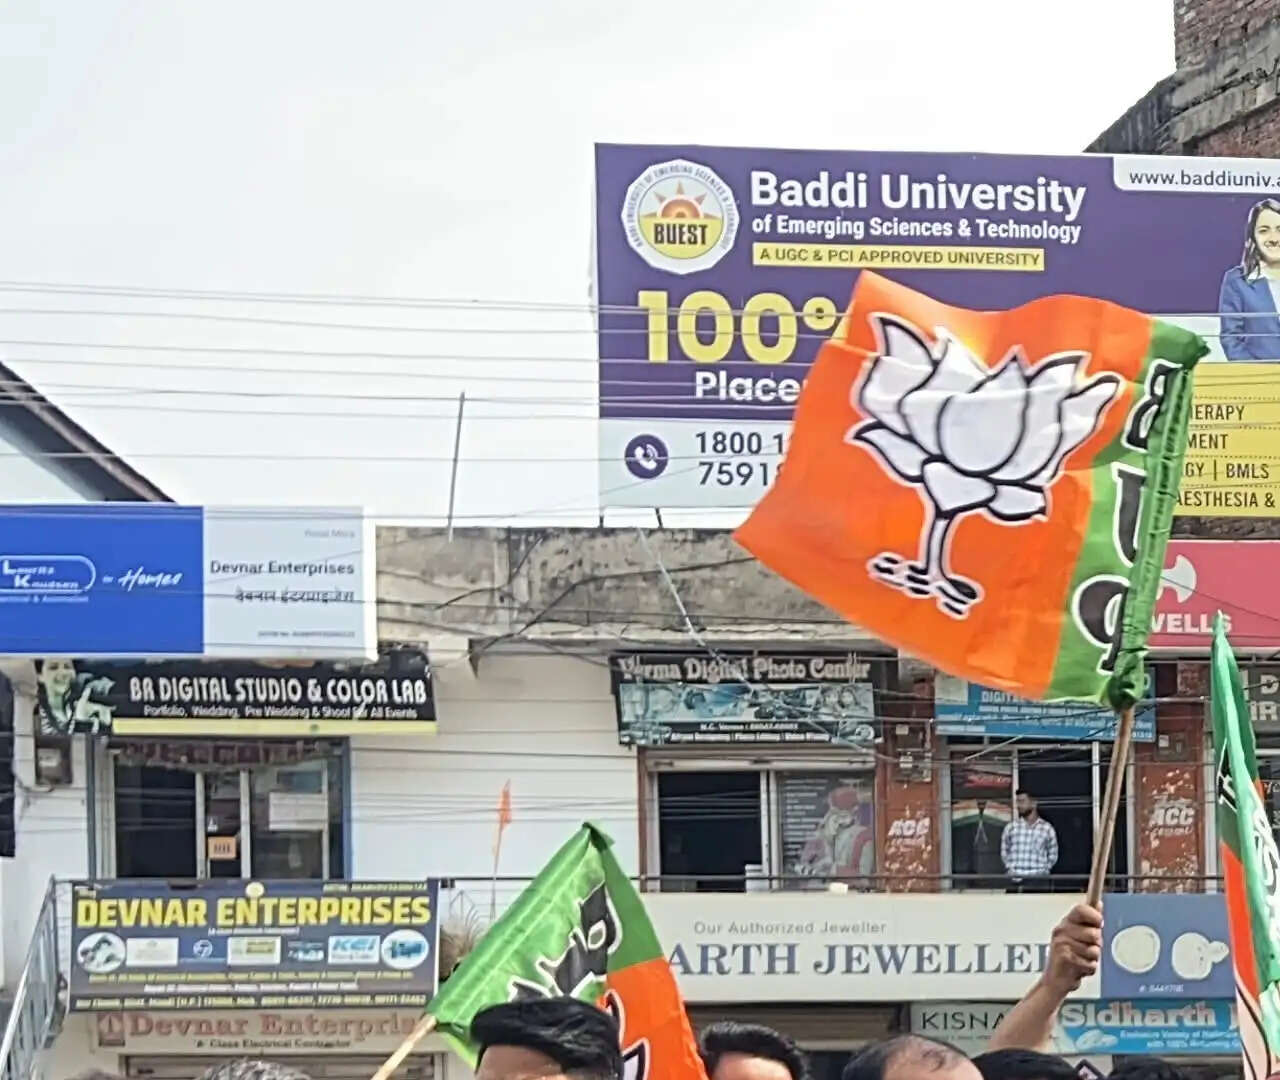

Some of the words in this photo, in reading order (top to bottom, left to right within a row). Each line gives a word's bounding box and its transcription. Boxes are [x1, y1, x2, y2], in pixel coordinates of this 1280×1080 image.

[750, 170, 868, 209] Baddi
[880, 174, 1087, 222] University
[653, 223, 708, 246] BUEST
[751, 213, 772, 234] of
[776, 214, 865, 239] Emerging
[869, 216, 953, 237] Sciences
[958, 219, 972, 237] &
[975, 218, 1082, 244] Technology
[759, 249, 771, 261] A
[774, 249, 809, 262] UGC
[812, 249, 823, 262] &
[828, 250, 854, 263] PCI
[858, 251, 944, 264] APPROVED
[947, 252, 1041, 266] UNIVERSITY
[695, 371, 804, 402] Place
[695, 431, 762, 454] 1800
[699, 462, 786, 486] 7591
[1226, 463, 1270, 479] BMLS
[1264, 492, 1276, 508] &
[210, 559, 263, 575] Devnar
[268, 559, 355, 577] Enterprises
[752, 657, 807, 680] Photo
[809, 658, 871, 680] Center
[159, 676, 231, 702] DIGITAL
[235, 677, 301, 702] STUDIO
[307, 679, 323, 702] &
[326, 679, 388, 703] COLOR
[392, 679, 427, 703] LAB
[888, 818, 930, 836] ACC
[1150, 805, 1195, 826] ACC
[77, 897, 208, 928] DEVNAR
[216, 895, 432, 927] ENTERPRISES
[694, 920, 723, 935] Our
[728, 920, 815, 935] Authorized
[820, 921, 887, 935] Jeweller
[669, 942, 801, 976] ARTH
[129, 1012, 249, 1036] Devnar
[1061, 1000, 1219, 1028] Sidharth
